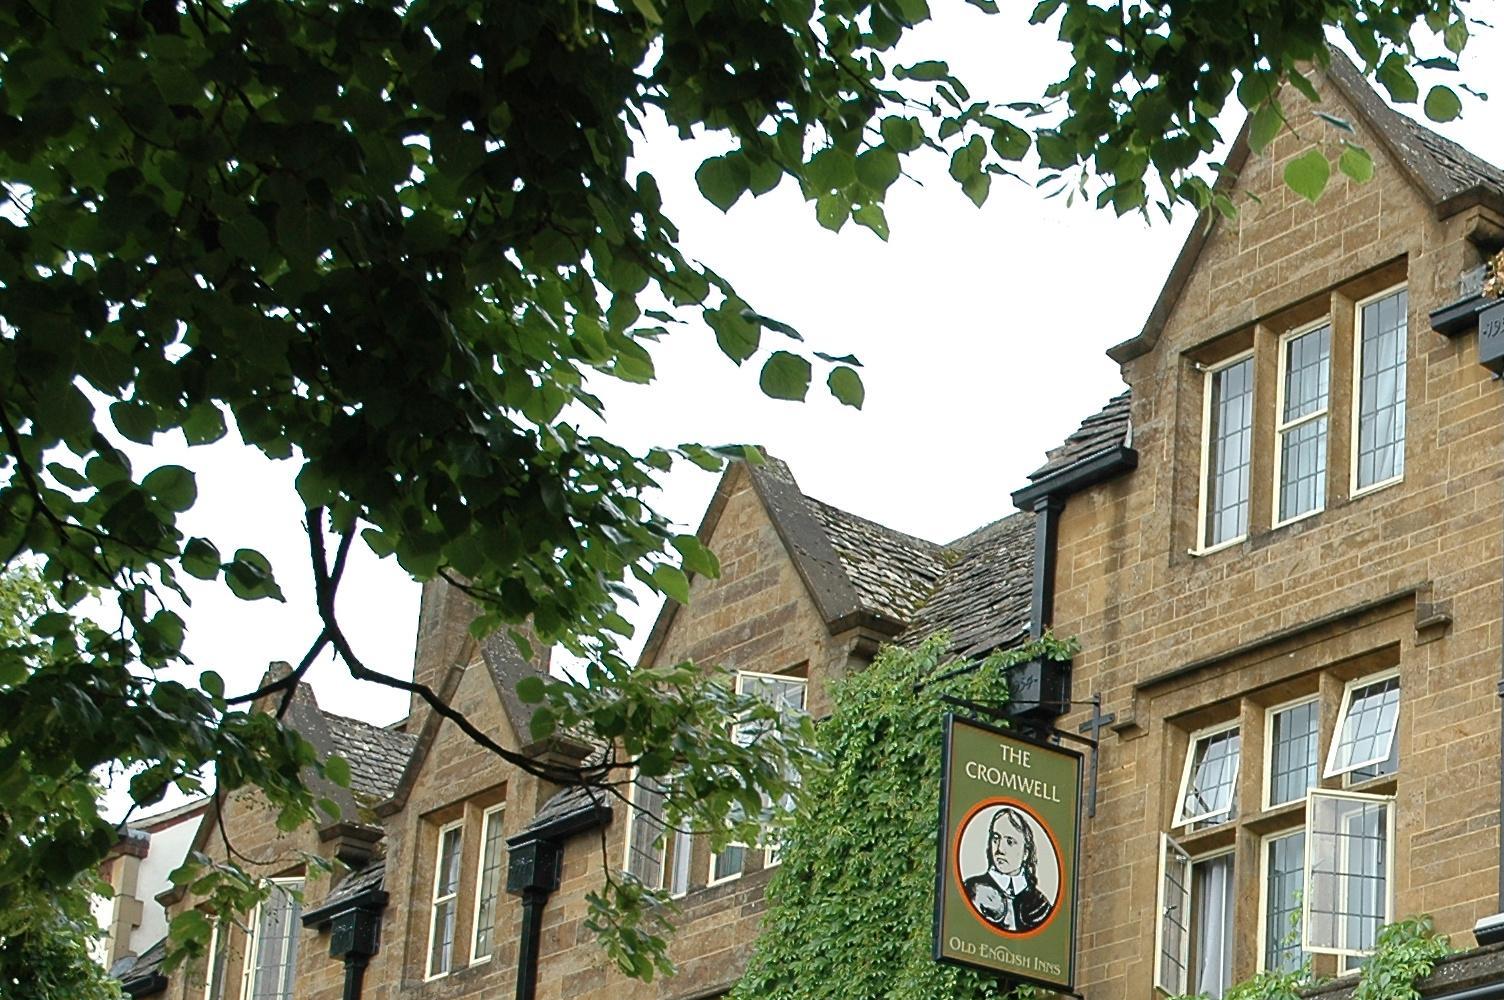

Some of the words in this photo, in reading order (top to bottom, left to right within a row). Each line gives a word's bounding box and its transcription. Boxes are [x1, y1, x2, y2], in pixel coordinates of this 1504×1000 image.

[1000, 744, 1031, 769] THE
[965, 761, 1061, 802] CROMWELL
[949, 936, 976, 955] OLD
[980, 943, 1031, 969] ENGLISH
[1034, 956, 1061, 976] INNS
